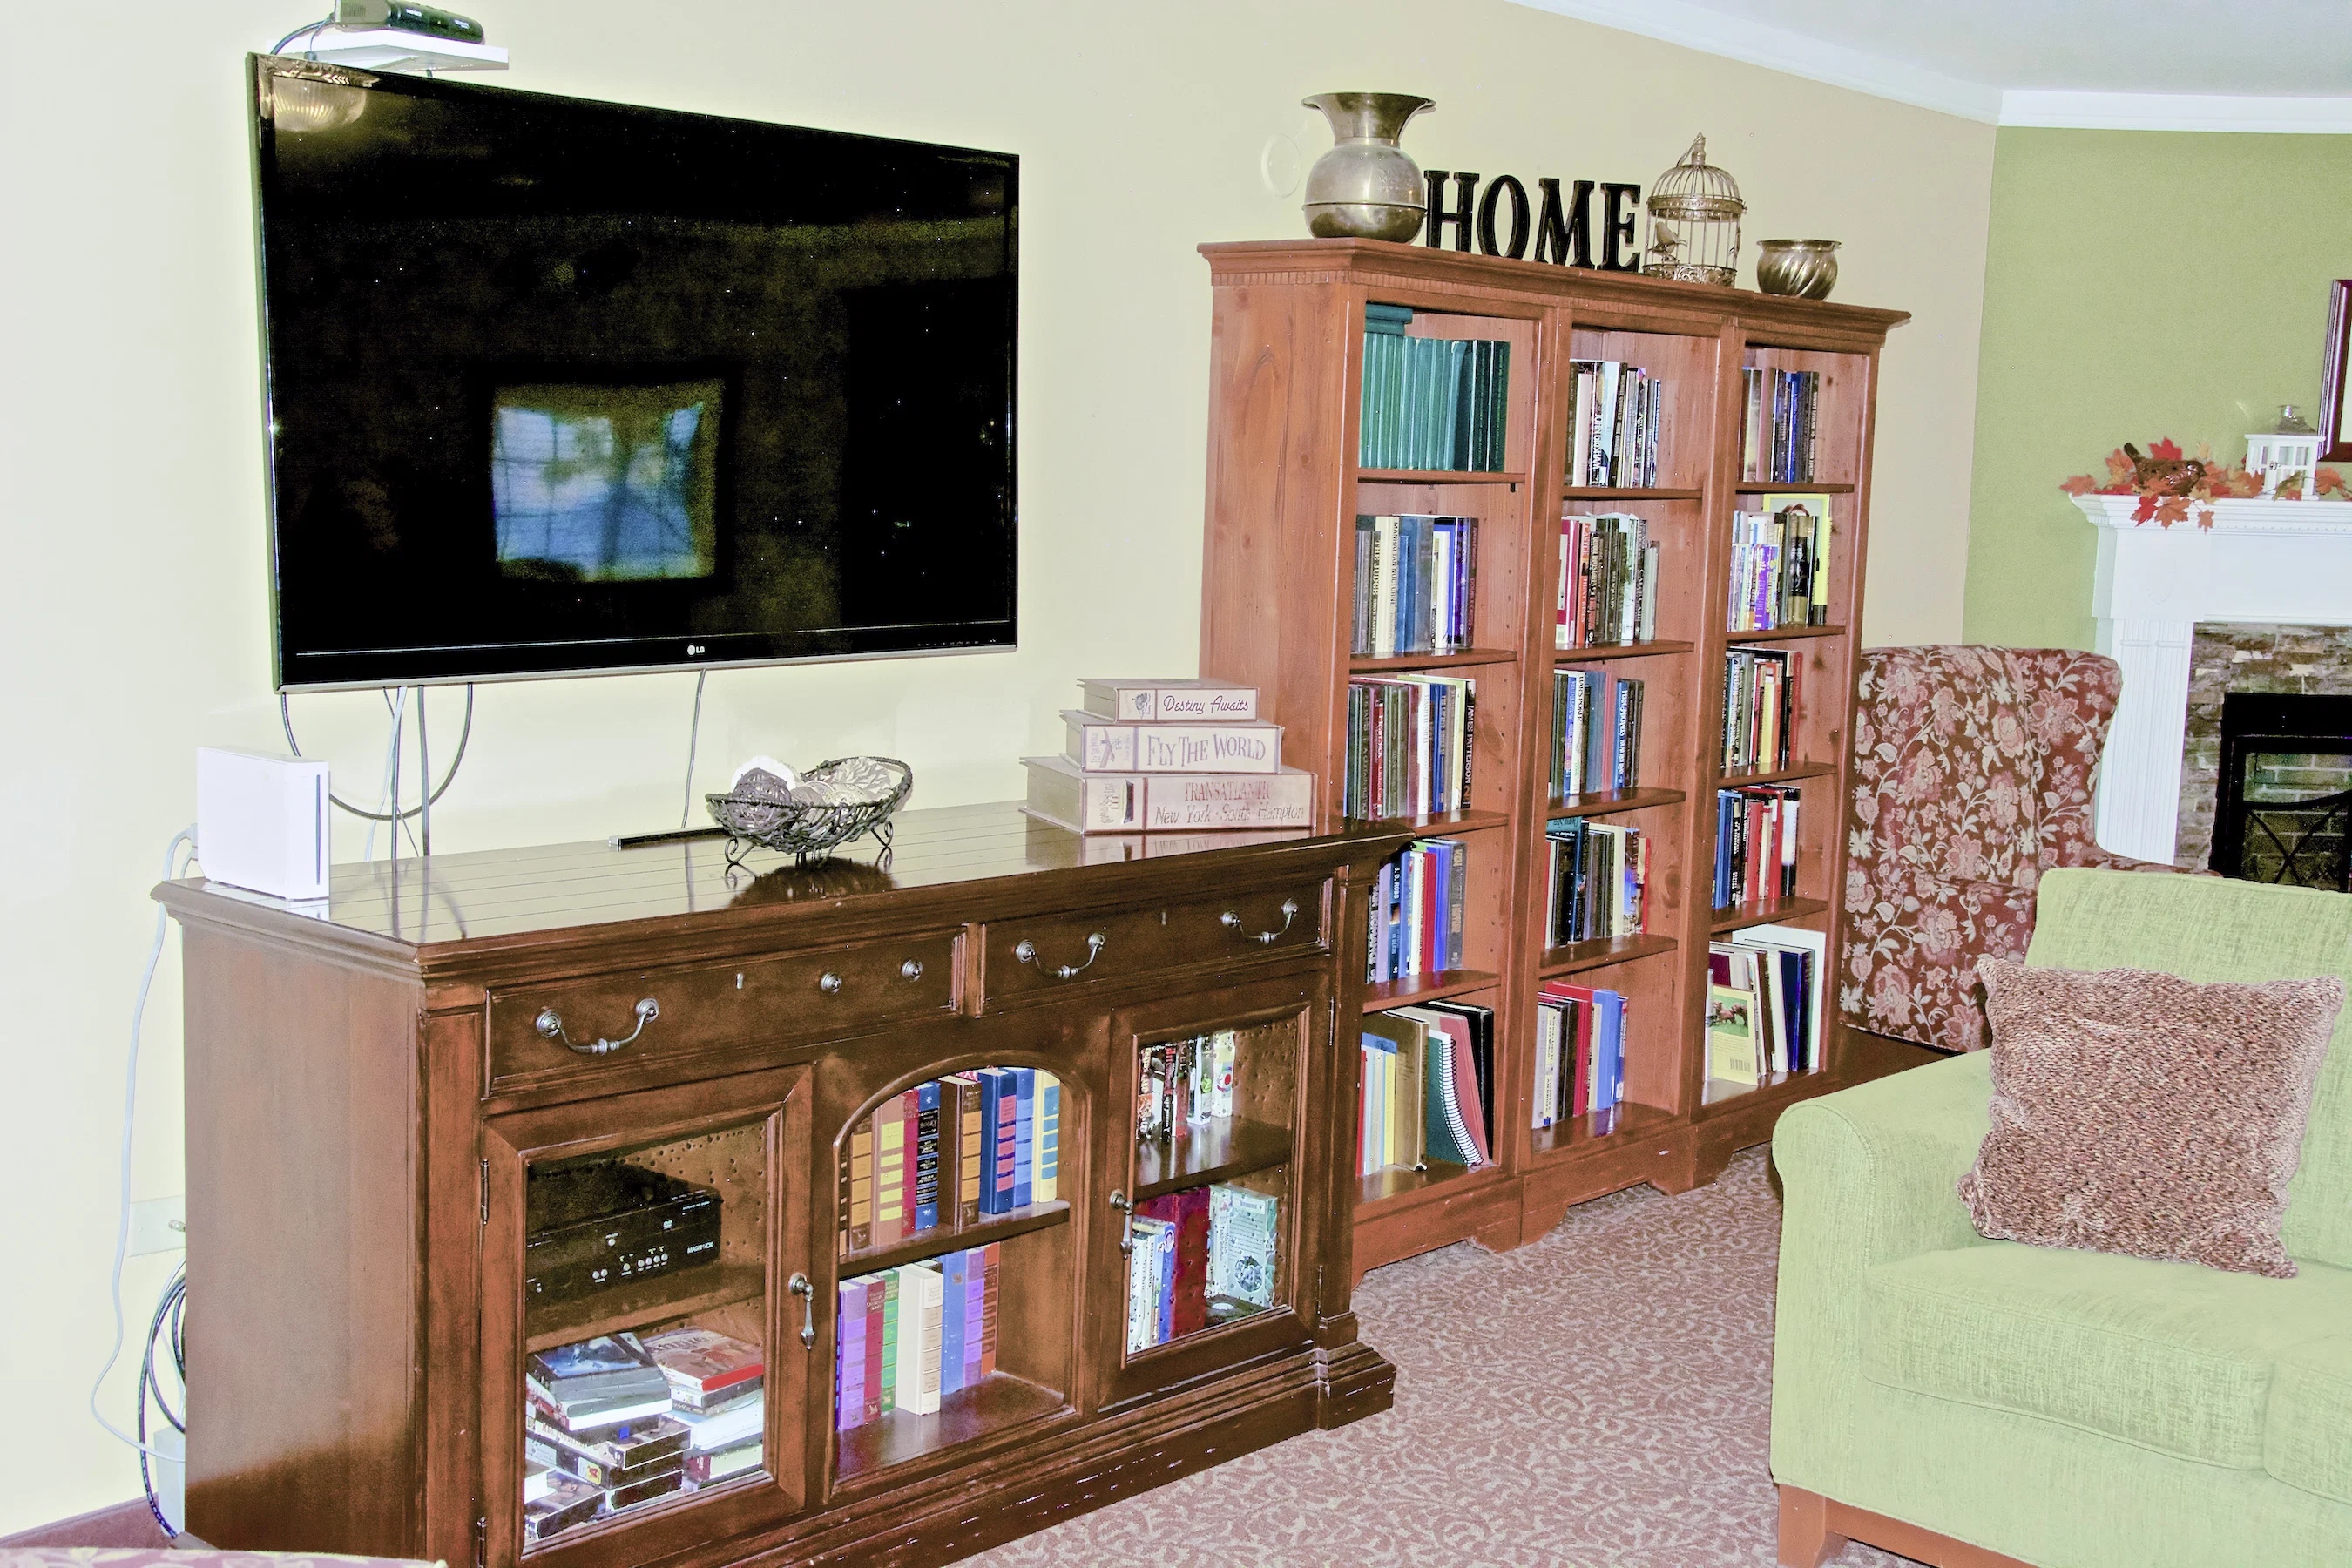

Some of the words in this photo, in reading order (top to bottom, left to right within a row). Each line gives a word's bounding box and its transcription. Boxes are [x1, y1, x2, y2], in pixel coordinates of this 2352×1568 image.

[1423, 170, 1641, 272] HOME
[1594, 413, 1604, 434] JOHN
[1592, 435, 1602, 469] GRISHAM
[1163, 695, 1205, 714] Destiny
[1210, 694, 1249, 713] Awaits
[1146, 735, 1177, 767] FLY
[1179, 735, 1208, 767] THE
[1213, 733, 1267, 760] WORLD
[1465, 733, 1474, 783] PATTERSON
[1185, 781, 1271, 801] TRANSATLANTIC
[1154, 806, 1179, 825] New
[1186, 805, 1211, 822] York
[1219, 804, 1253, 821] South
[1258, 802, 1305, 821] Hampton
